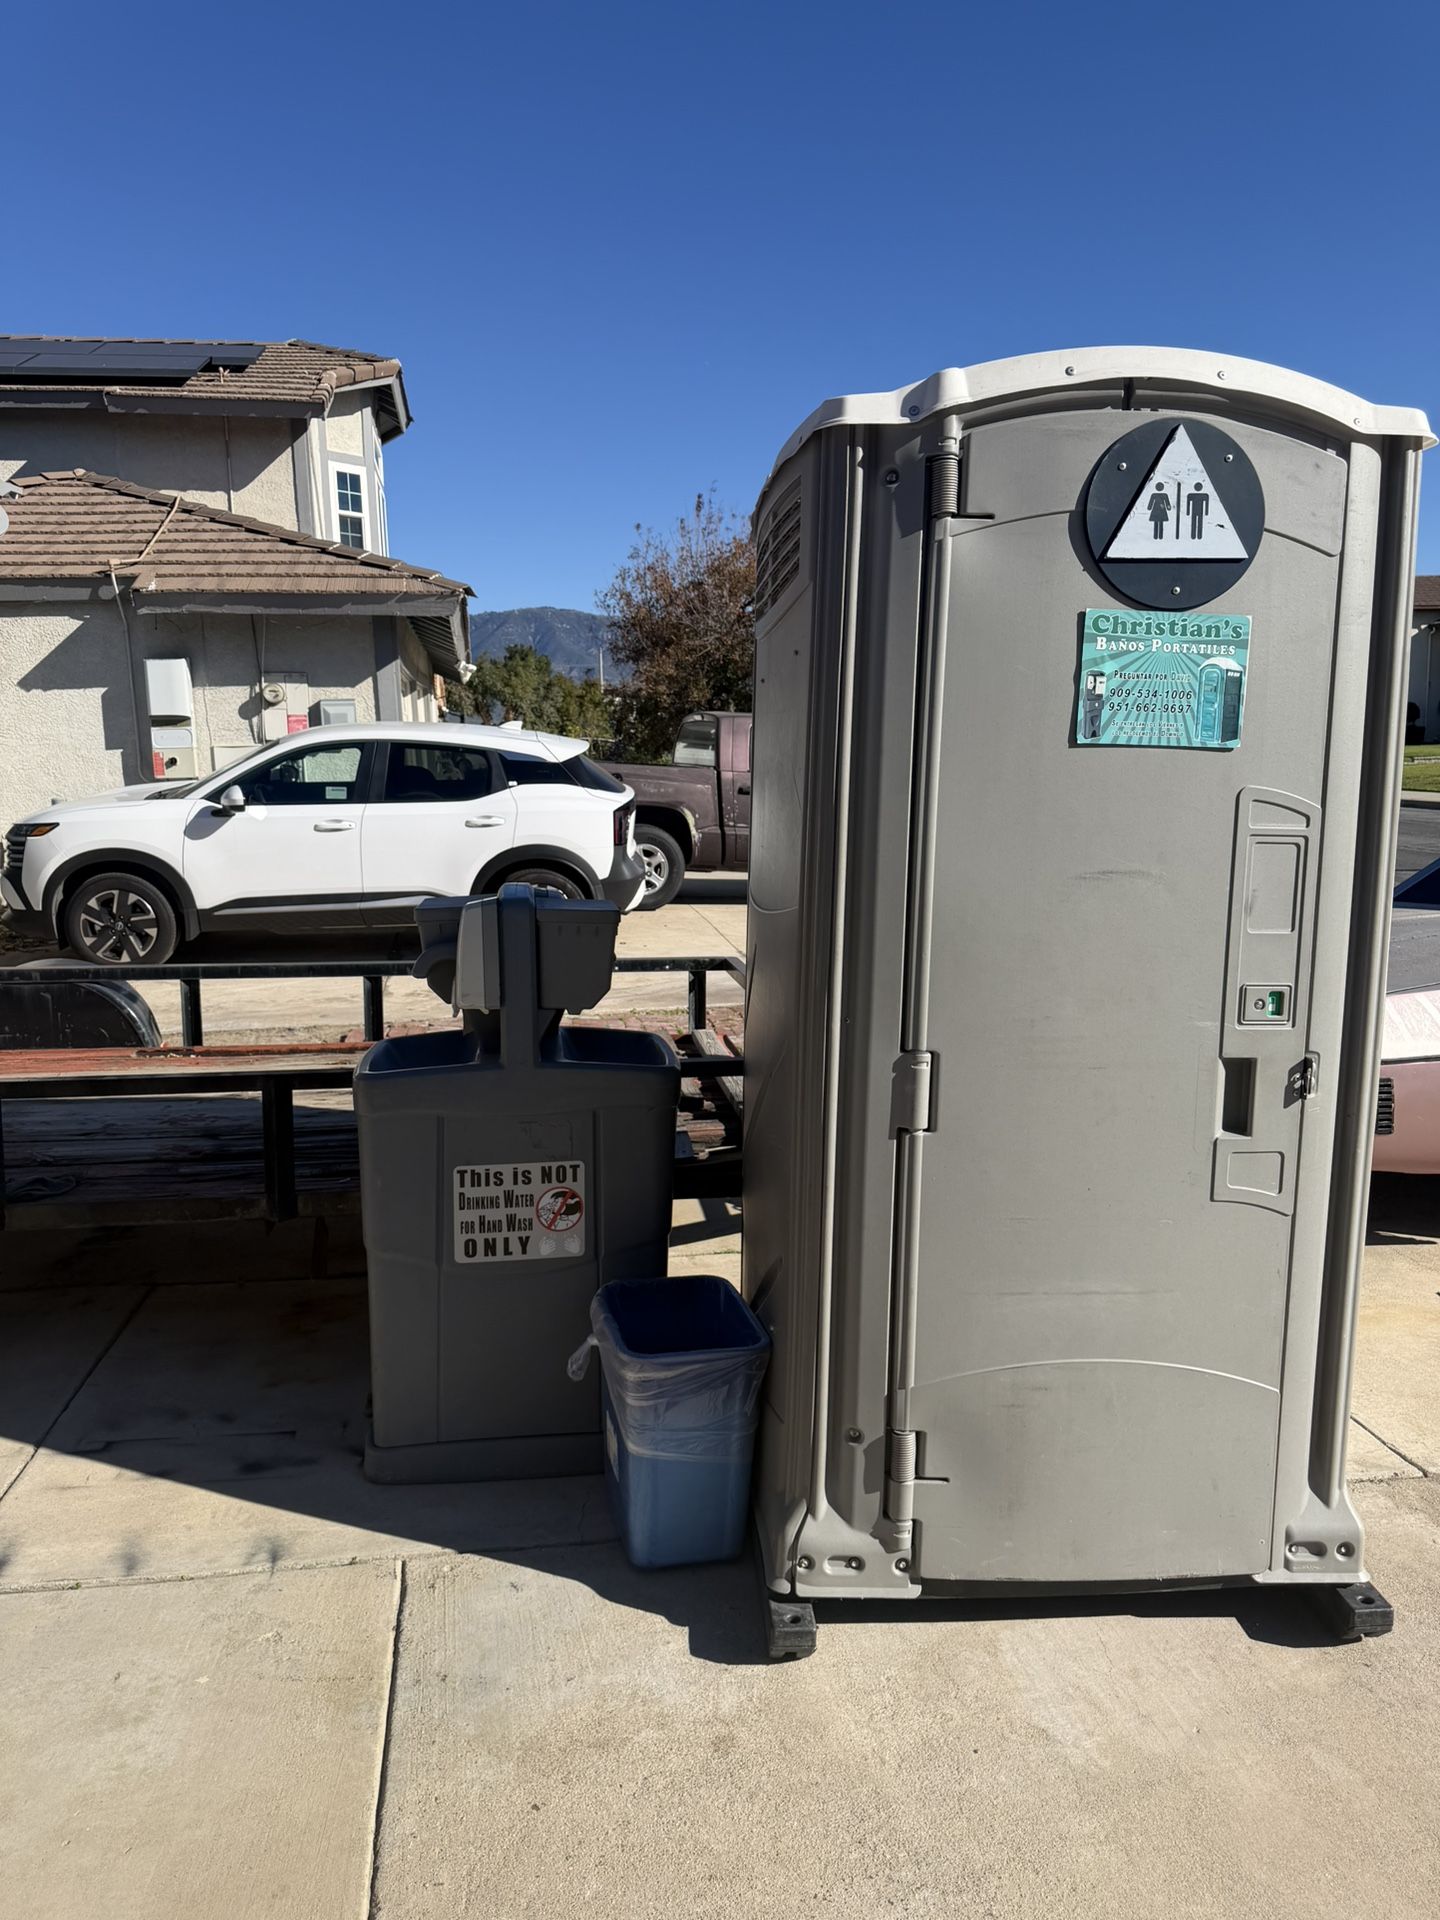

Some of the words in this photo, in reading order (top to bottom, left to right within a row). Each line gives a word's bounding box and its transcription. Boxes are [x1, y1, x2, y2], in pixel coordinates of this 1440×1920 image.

[1092, 614, 1243, 639] Christian's
[1096, 636, 1145, 652] BAÑOS
[1151, 638, 1236, 655] PORTATILES
[1109, 688, 1192, 700] 909-534-1006
[1108, 701, 1192, 714] 951-662-9697
[457, 1168, 504, 1188] This
[512, 1167, 533, 1186] is
[540, 1164, 580, 1184] NOT
[458, 1191, 500, 1211] DRINKING
[503, 1189, 535, 1209] WATER
[478, 1214, 503, 1234] HAND
[505, 1213, 534, 1233] WASH
[463, 1235, 531, 1258] ONLY
